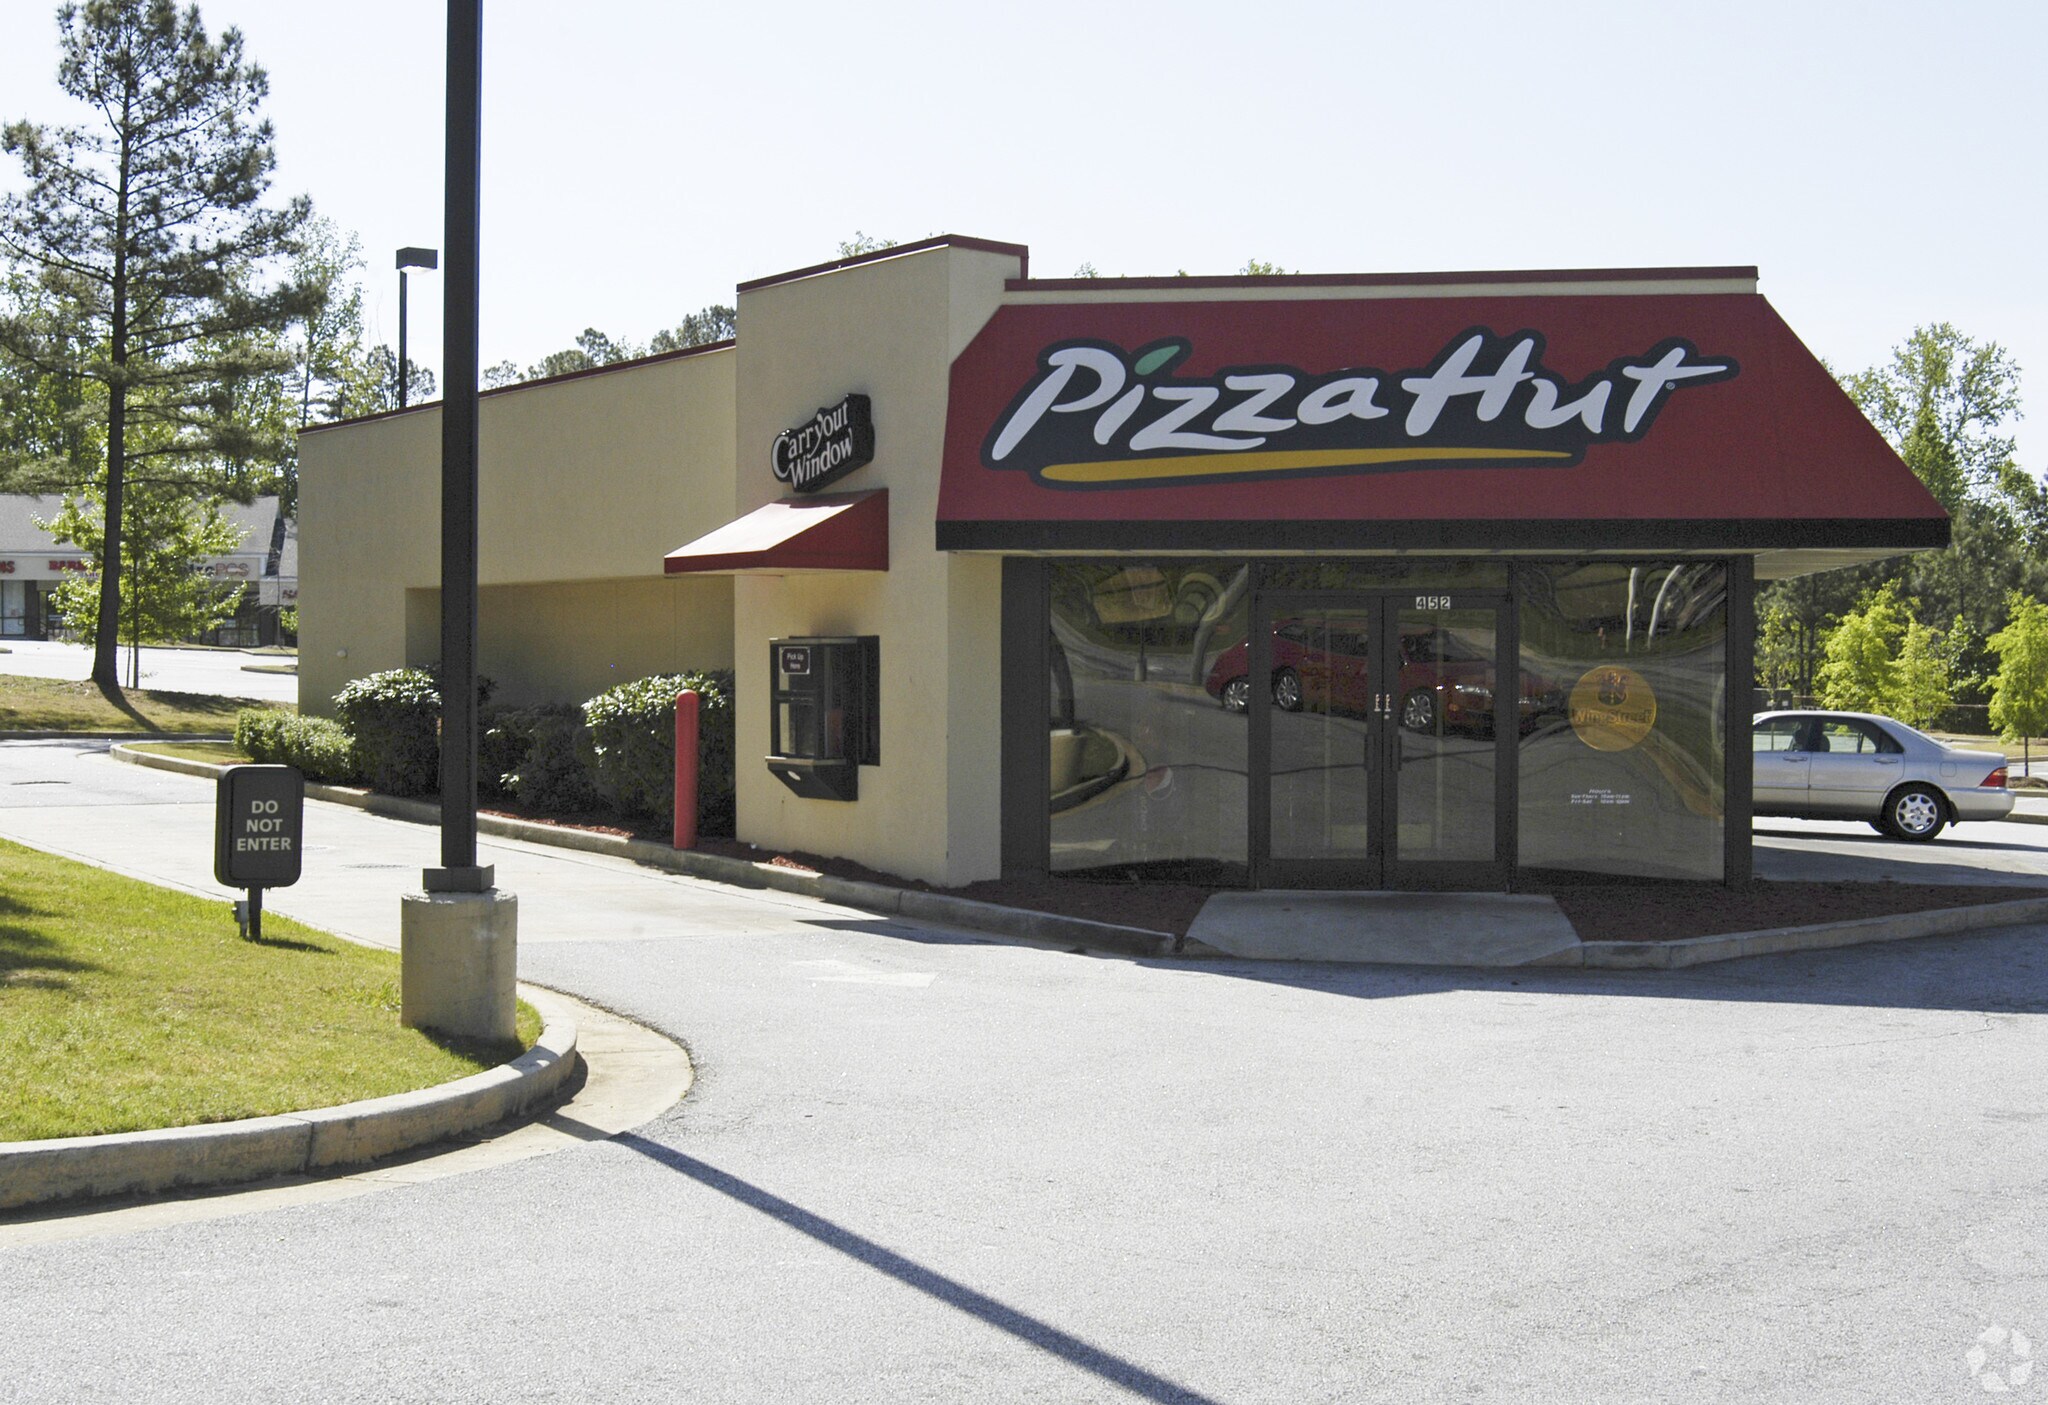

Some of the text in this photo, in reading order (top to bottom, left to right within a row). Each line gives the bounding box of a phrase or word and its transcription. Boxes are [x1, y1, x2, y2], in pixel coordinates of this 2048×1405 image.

[991, 335, 1728, 461] Pizza Hut
[789, 427, 853, 488] Window
[1416, 597, 1450, 609] 452
[251, 800, 278, 814] DO
[246, 819, 283, 832] NOT
[236, 838, 291, 851] ENTER
